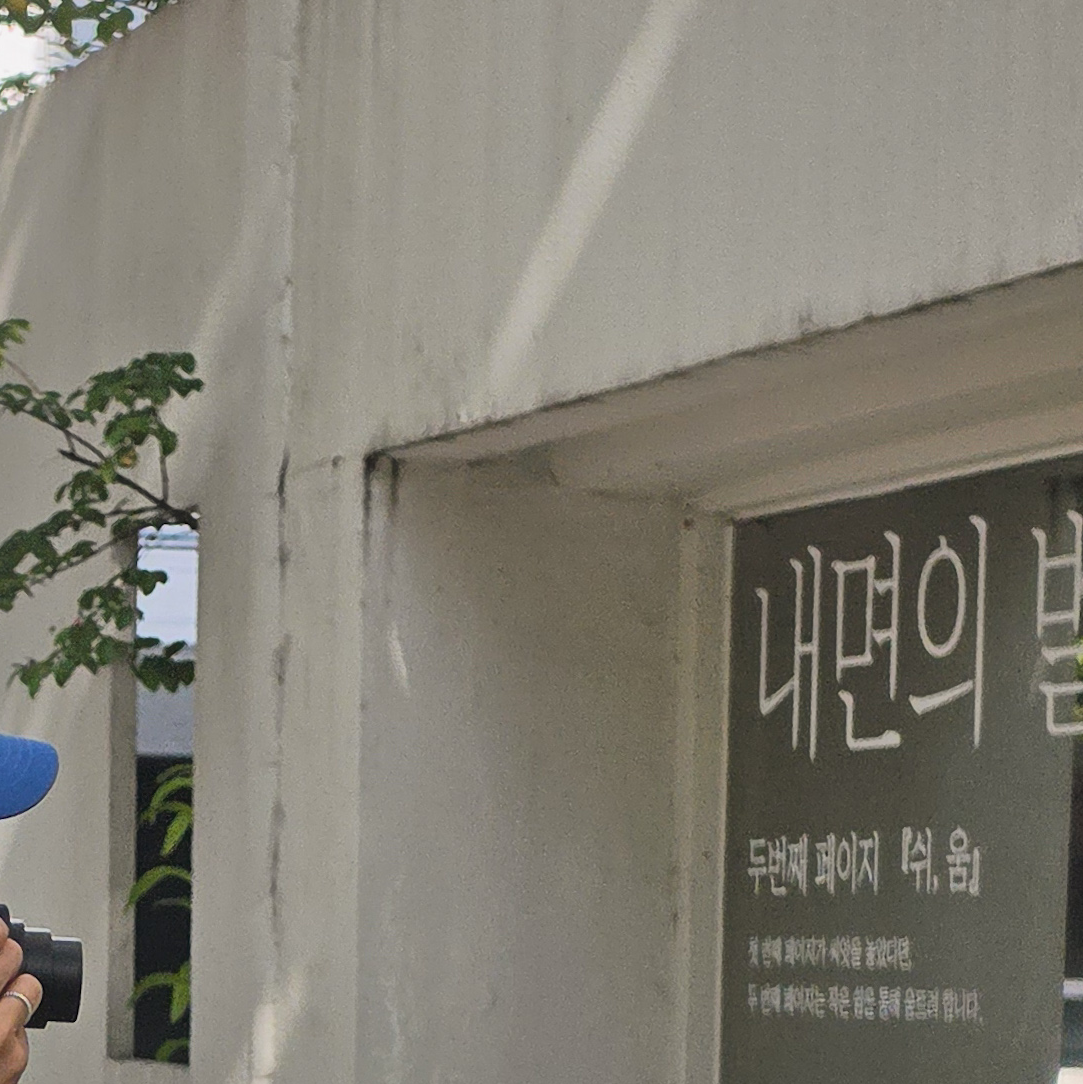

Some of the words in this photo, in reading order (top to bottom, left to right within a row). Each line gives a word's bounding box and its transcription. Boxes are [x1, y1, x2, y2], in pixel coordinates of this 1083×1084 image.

[755, 514, 988, 763] 내면의
[747, 832, 809, 897] 두번째
[815, 830, 879, 897] 페이지
